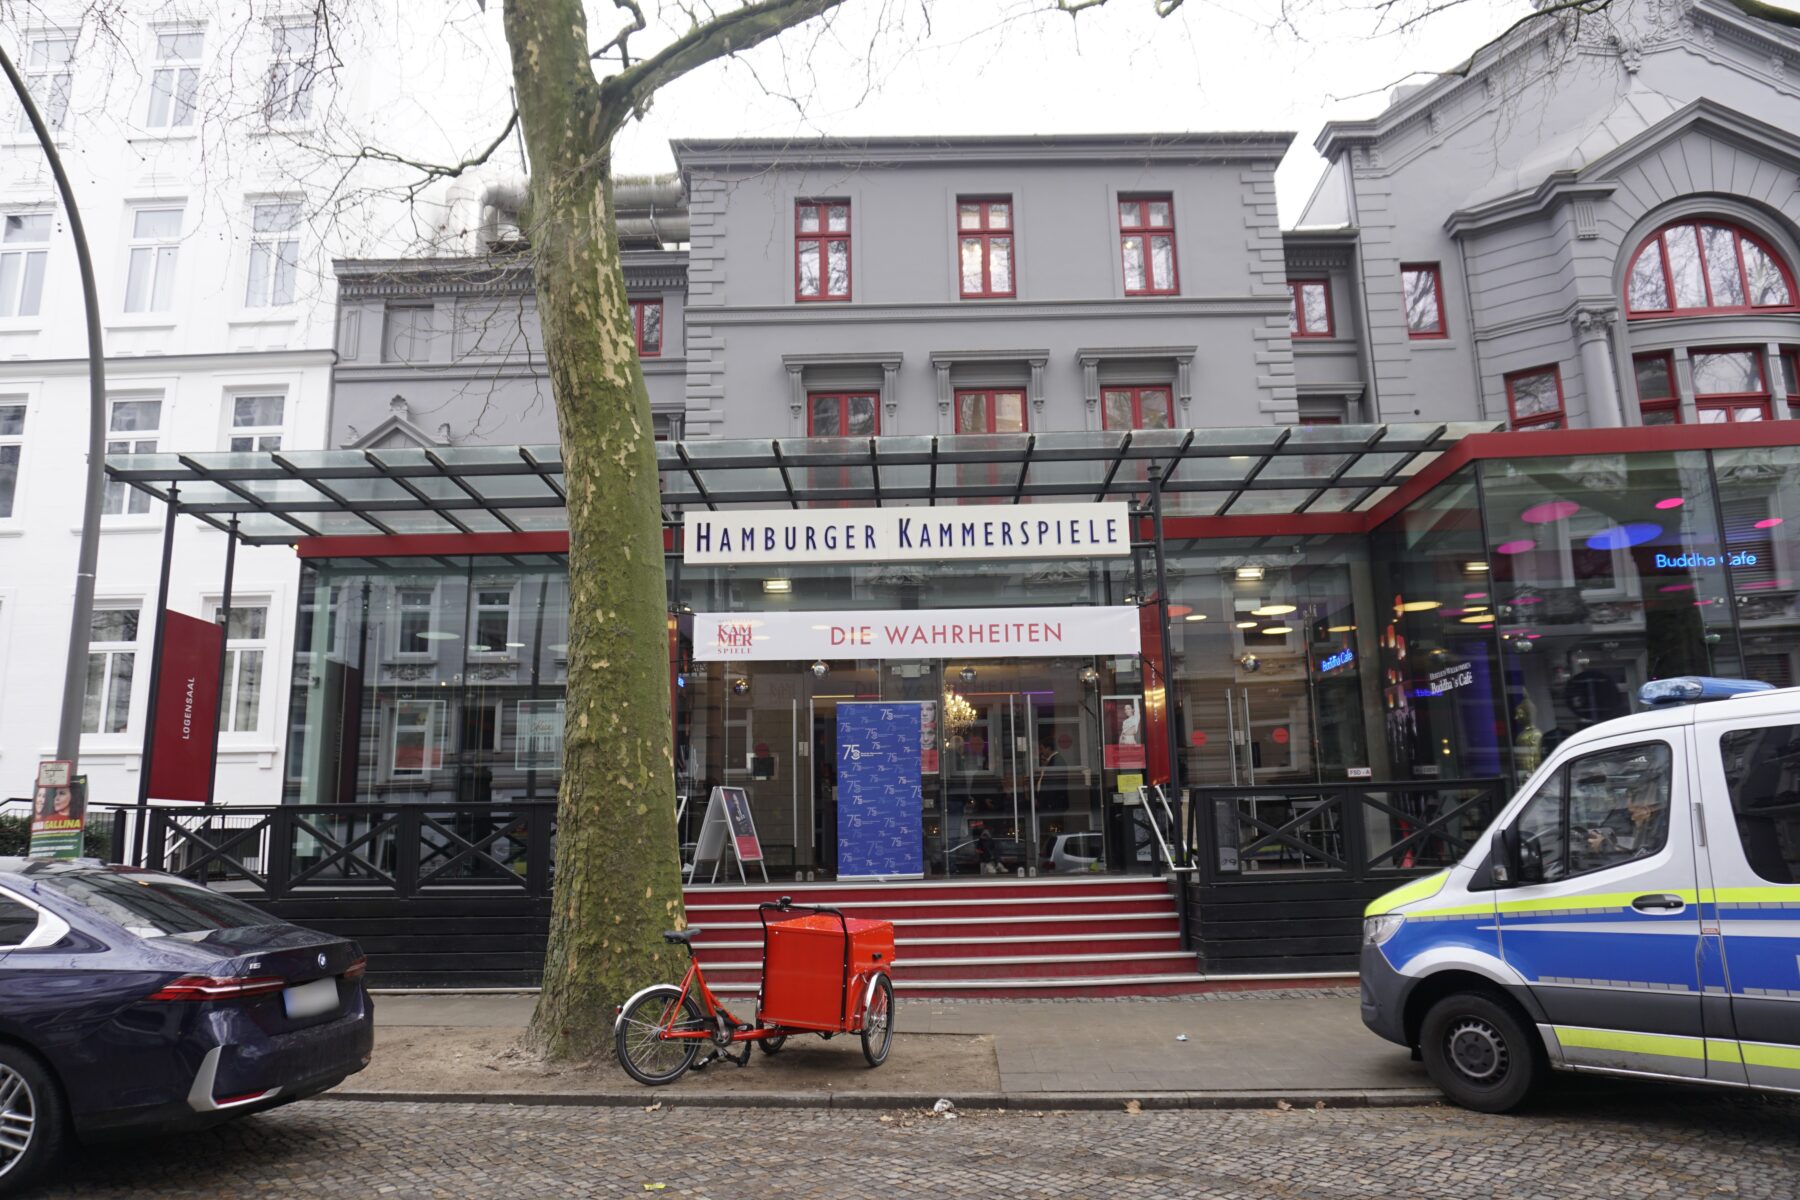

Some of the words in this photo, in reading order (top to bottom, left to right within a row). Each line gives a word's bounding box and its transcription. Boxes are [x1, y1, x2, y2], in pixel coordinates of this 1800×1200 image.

[696, 522, 876, 552] HAMBURGER
[898, 518, 1117, 548] KAMMERSPIELE
[1655, 552, 1716, 568] Buddha
[718, 624, 752, 635] KAM
[831, 626, 871, 646] DIE
[884, 623, 1062, 645] WAHRHEITEN
[718, 634, 752, 646] MER
[182, 677, 195, 740] LOGENSAAL
[880, 708, 893, 720] 75
[842, 744, 860, 760] 75
